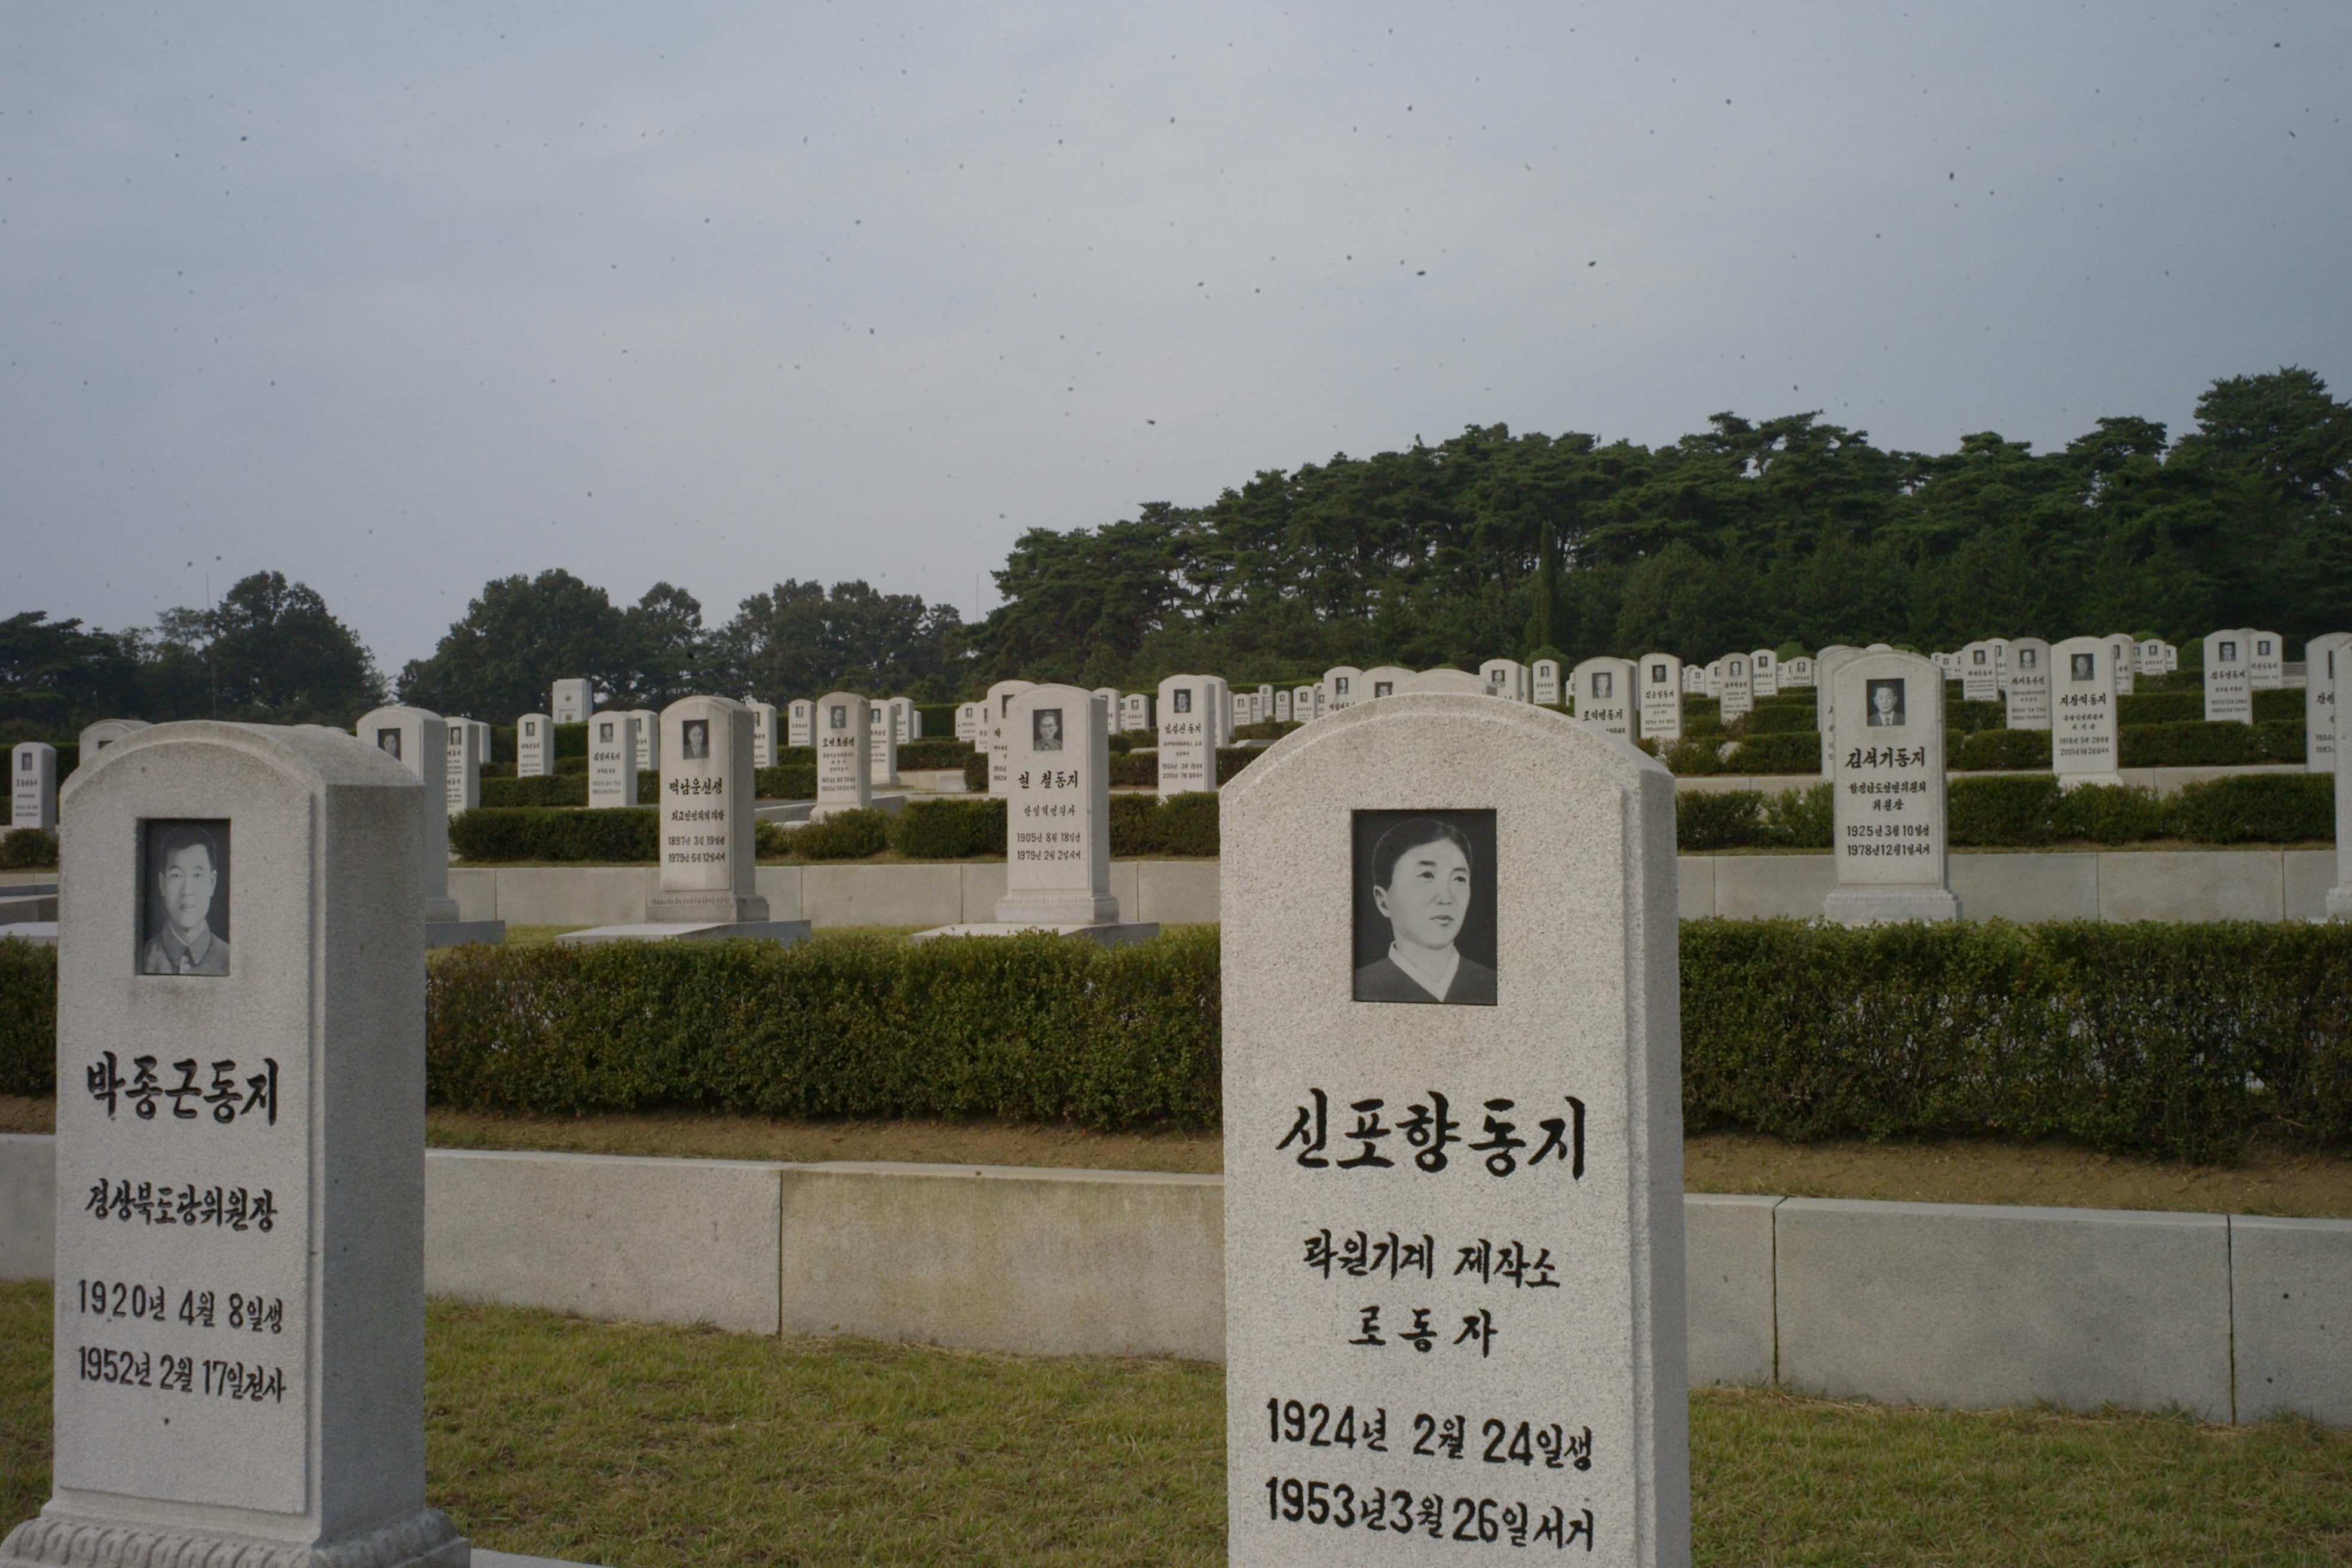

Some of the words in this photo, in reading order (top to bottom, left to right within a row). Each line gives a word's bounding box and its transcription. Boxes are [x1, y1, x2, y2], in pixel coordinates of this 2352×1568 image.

[1845, 746, 1925, 768] 김석기동지
[669, 777, 722, 795] 백남운선생
[1872, 798, 1904, 811] 위원장
[669, 836, 690, 846] 1897년
[1017, 832, 1042, 843] 1905년
[1046, 832, 1057, 843] 8월
[1017, 850, 1041, 860] 1979년
[1044, 850, 1055, 860] 2월
[1846, 825, 1882, 837] 1925년
[1885, 824, 1900, 837] 3월
[1903, 824, 1930, 837] 10일생
[87, 1052, 279, 1126] 박종근동지
[1276, 1087, 1587, 1181] 신포향동지
[85, 1178, 278, 1233] 경상북도당위원장
[1454, 1239, 1561, 1289] 제작소
[78, 1279, 166, 1321] 1920년
[179, 1290, 216, 1328] 4월
[228, 1294, 284, 1334] 8일생
[78, 1346, 151, 1388] 1952년
[160, 1353, 194, 1393] 2월
[203, 1359, 286, 1403] 17일전사
[1266, 1397, 1388, 1453] 1924년
[1413, 1413, 1465, 1458] 2월
[1483, 1419, 1593, 1471] 24일생
[1453, 1497, 1594, 1552] 26일서거
